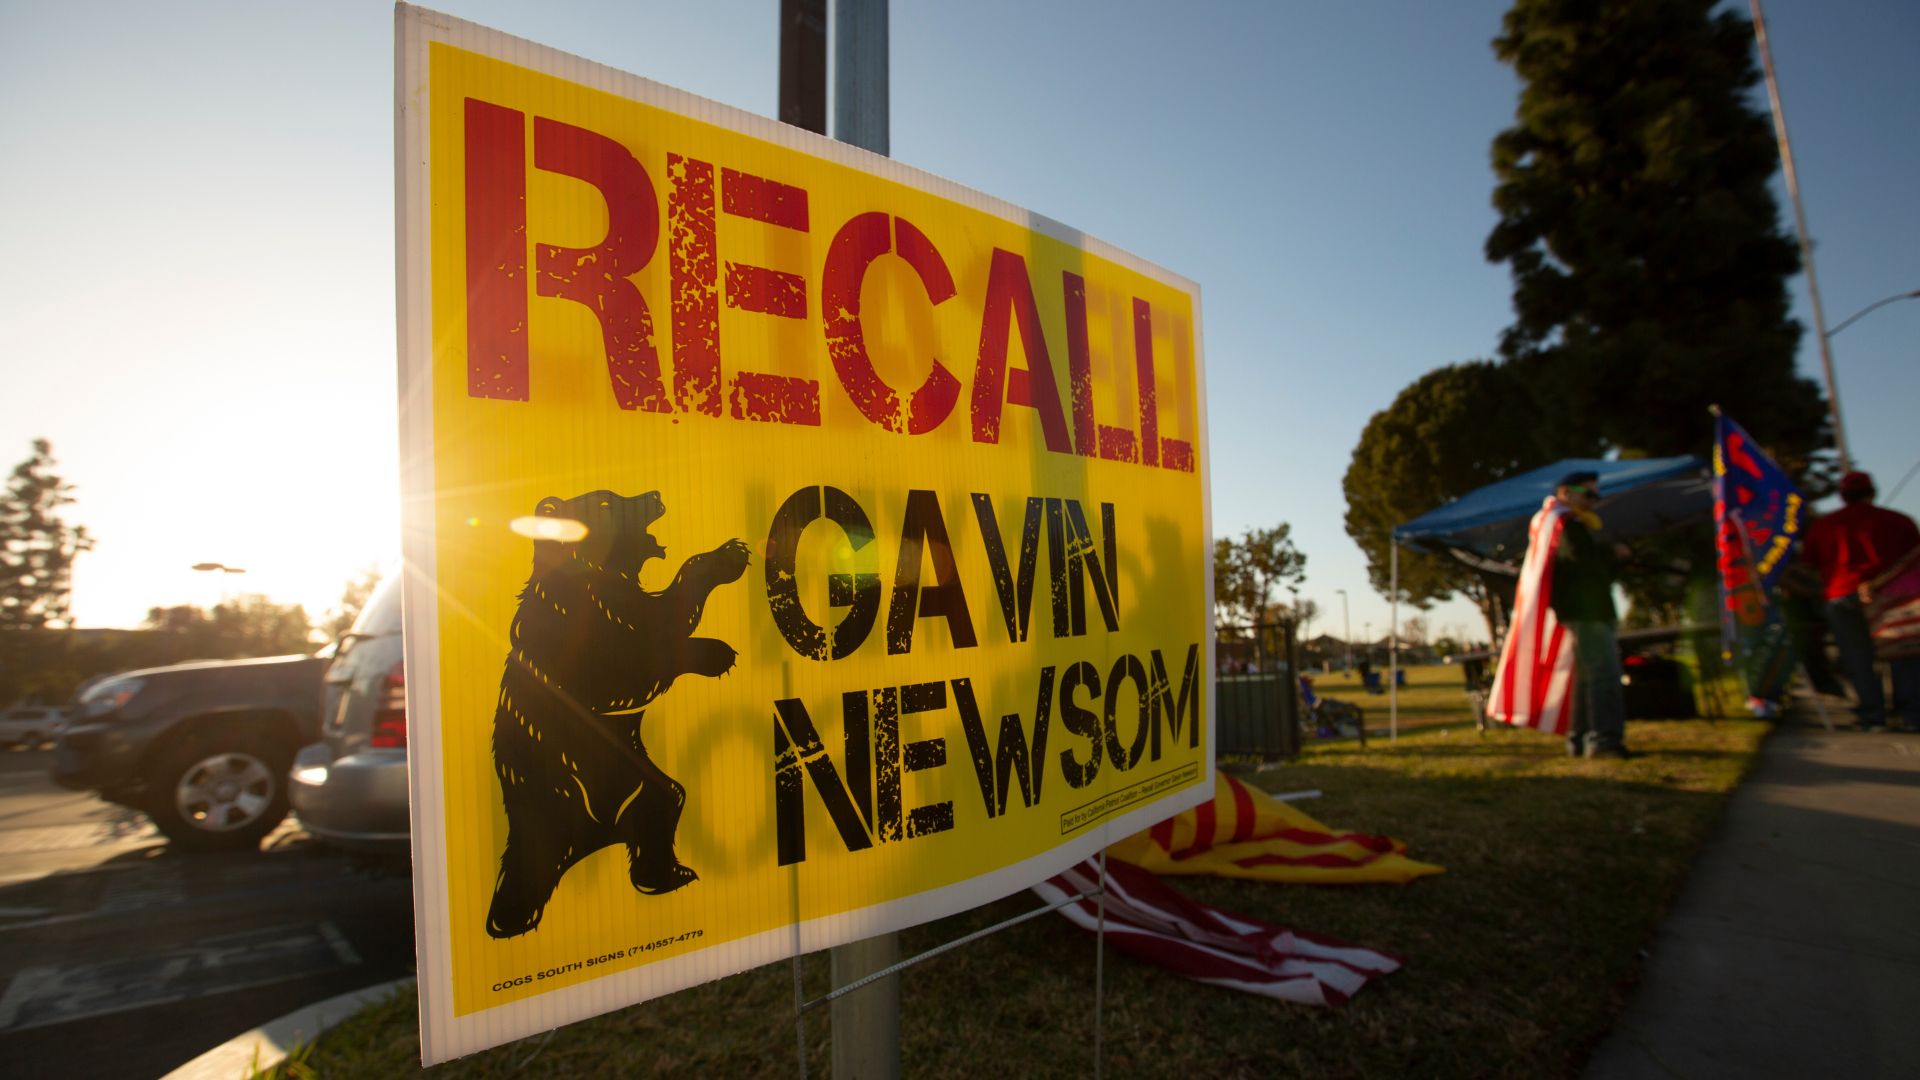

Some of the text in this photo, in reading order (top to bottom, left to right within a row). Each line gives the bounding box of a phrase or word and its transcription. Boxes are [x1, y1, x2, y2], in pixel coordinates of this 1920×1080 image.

[464, 97, 1195, 473] RECALL
[764, 485, 1120, 662] GAVIN
[773, 643, 1199, 867] NEWSOM
[492, 929, 704, 992] COGS SOUTH SIGNS (714)557-4779
